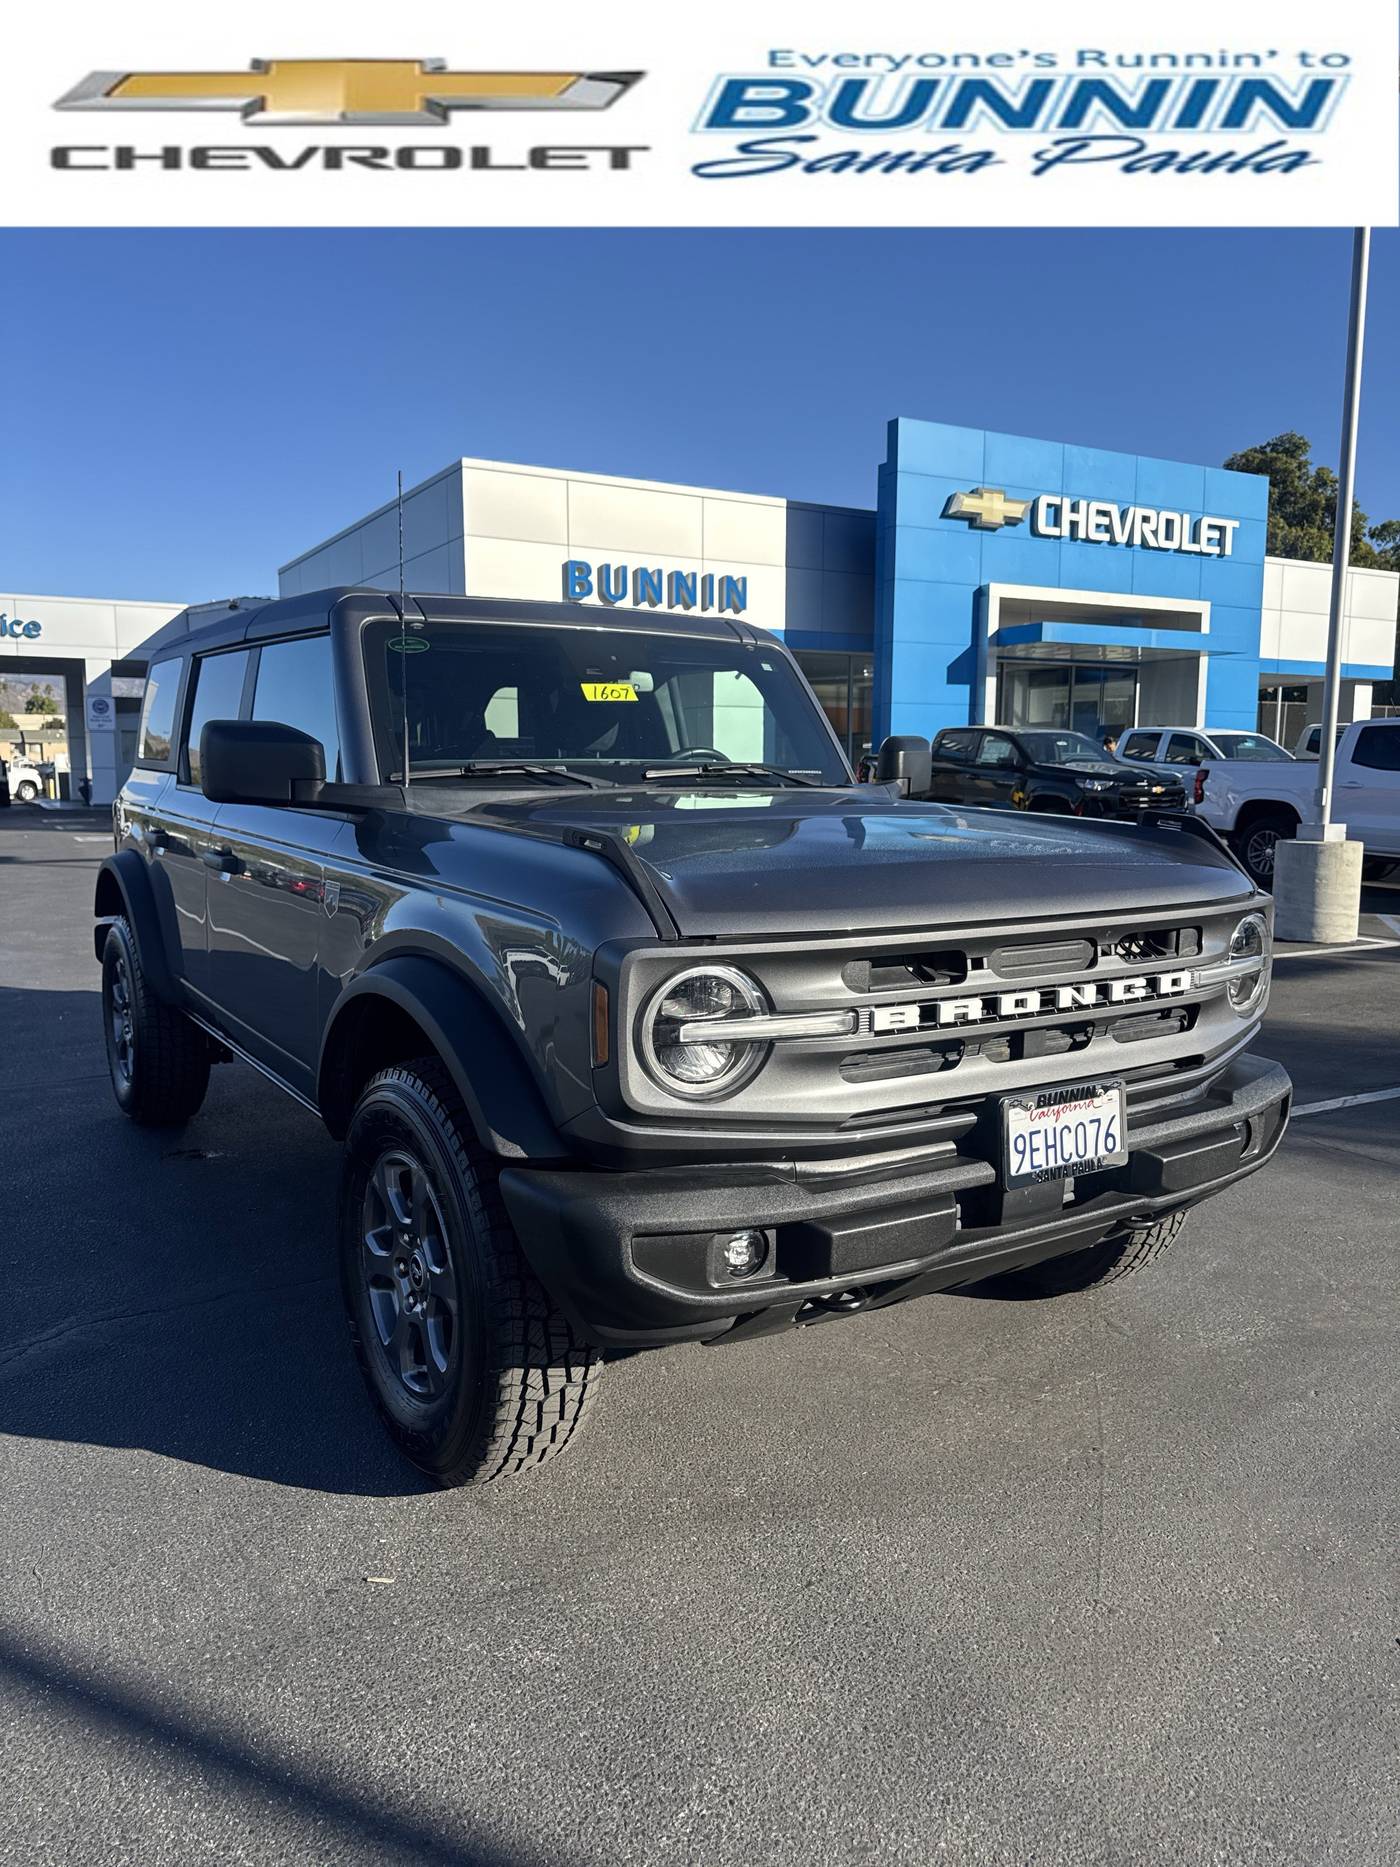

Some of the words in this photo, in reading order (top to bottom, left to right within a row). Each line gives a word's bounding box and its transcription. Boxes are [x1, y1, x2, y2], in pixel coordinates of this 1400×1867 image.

[1035, 494, 1240, 556] CHEVROLET
[563, 559, 748, 614] BUNNIN
[594, 685, 629, 699] 1607
[1029, 1098, 1103, 1124] California
[1035, 1084, 1098, 1109] BUNNIN
[1013, 1114, 1117, 1174] 9EHC076
